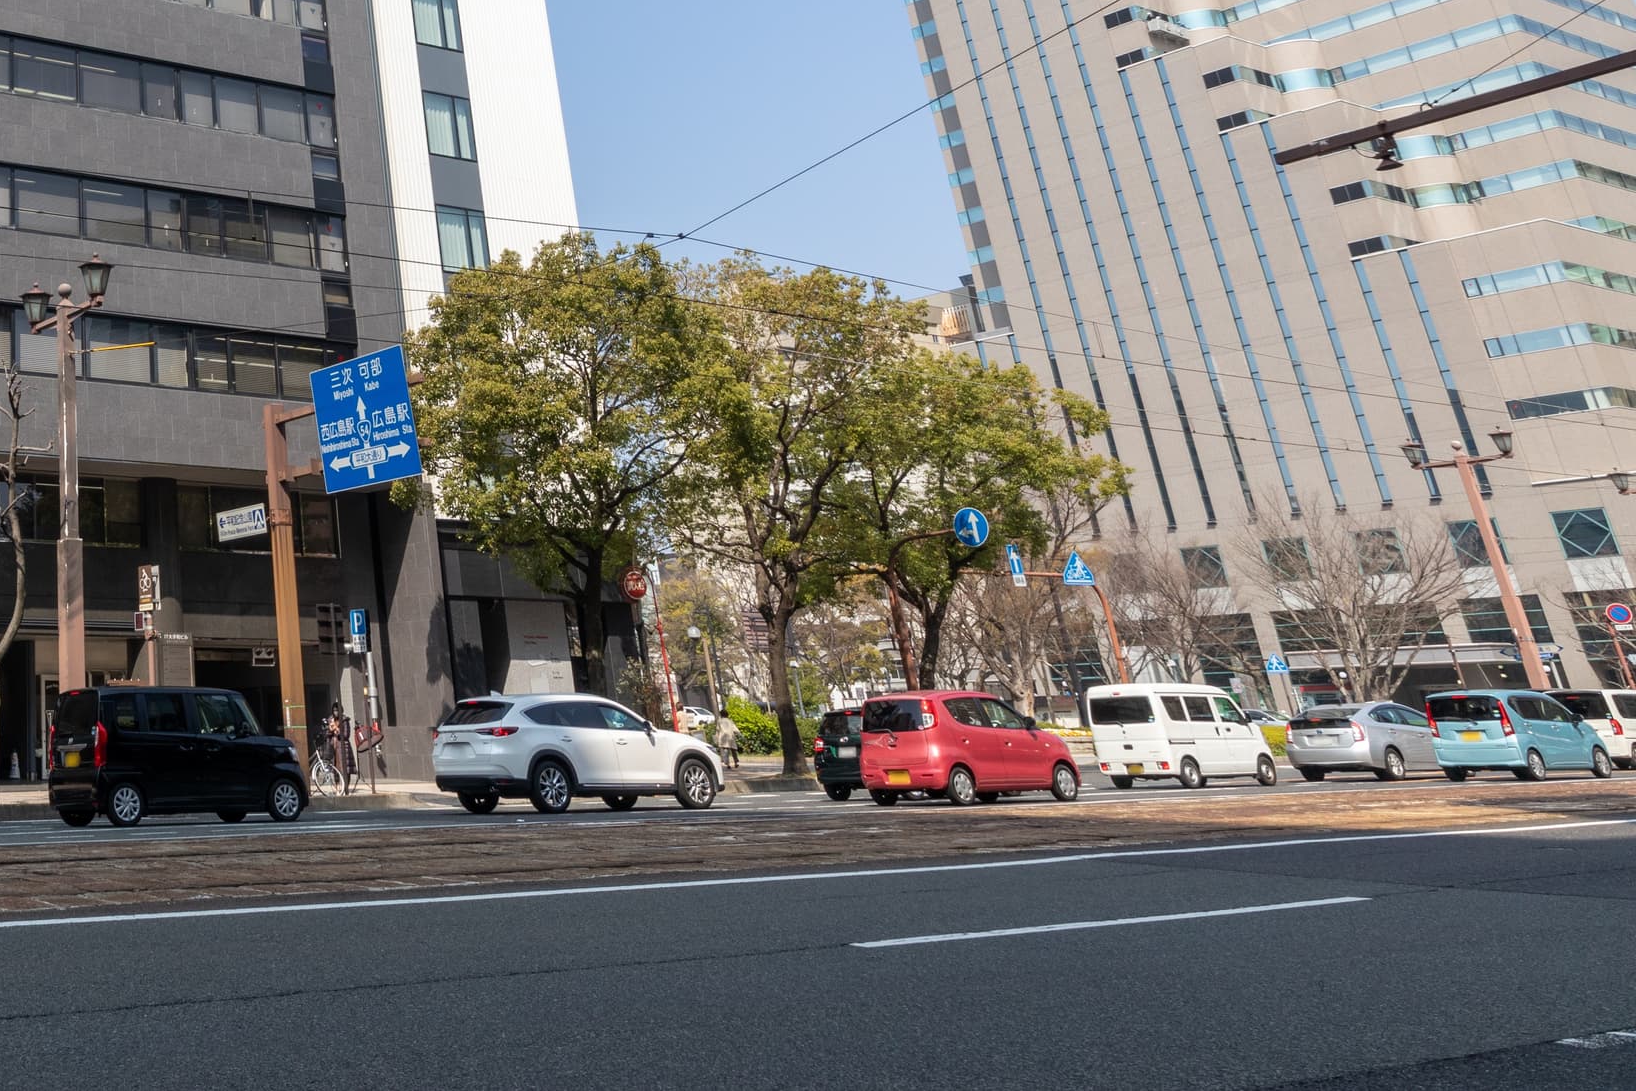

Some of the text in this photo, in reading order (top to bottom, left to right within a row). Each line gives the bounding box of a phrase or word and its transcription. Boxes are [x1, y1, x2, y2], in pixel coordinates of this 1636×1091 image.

[330, 357, 382, 389] 三次 可部
[333, 380, 380, 401] Miyoshi Kabe
[371, 402, 411, 429] 広島駅
[320, 417, 356, 441] 西広島駅
[360, 423, 369, 436] 54
[372, 424, 413, 442] Hiroshima Sta
[353, 612, 363, 633] P
